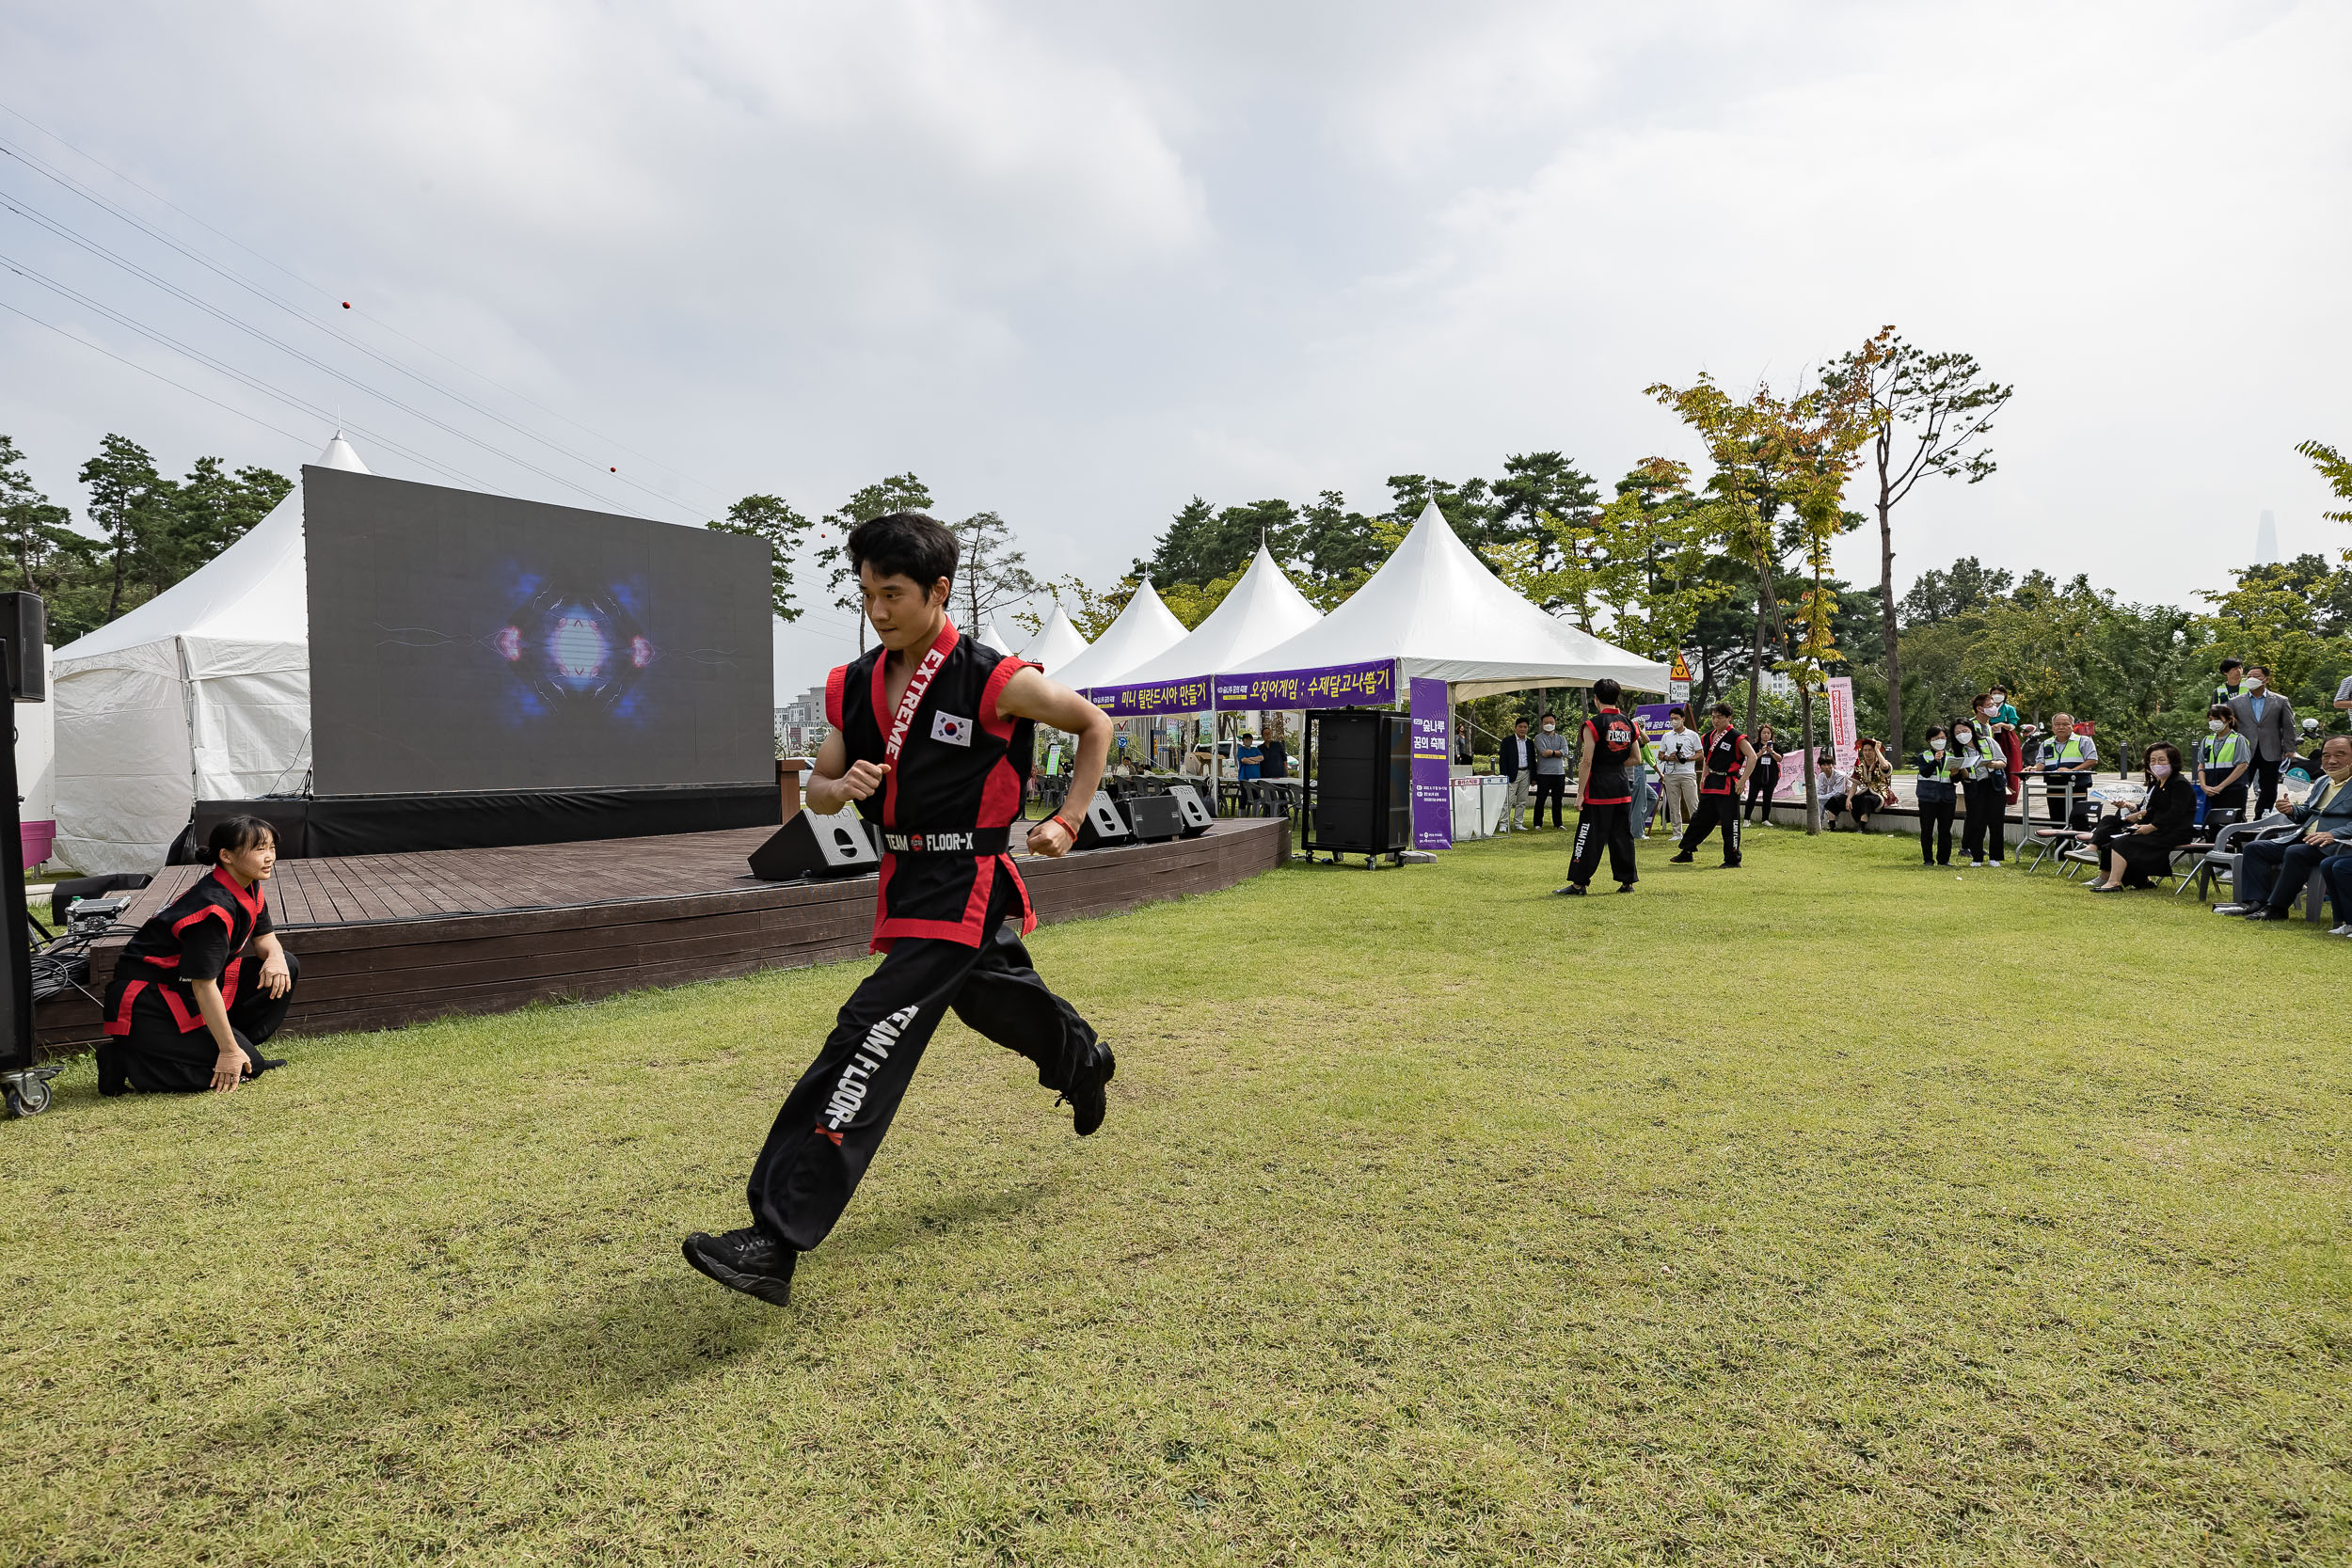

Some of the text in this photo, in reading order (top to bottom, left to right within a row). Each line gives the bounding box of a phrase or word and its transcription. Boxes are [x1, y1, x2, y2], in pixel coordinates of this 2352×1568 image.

[1121, 682, 1206, 709] 미니 틸란드시아 만들기
[1249, 678, 1298, 703] 오징어게임
[1308, 669, 1390, 698] 수제달고나뽑기
[886, 648, 946, 760] EXTREME
[1422, 720, 1445, 733] 숲나루
[1414, 736, 1446, 751] 꿈의 축제
[884, 832, 974, 851] TEAM FLOOR-X
[1579, 823, 1591, 839] TEAM
[862, 1005, 919, 1059] TEAM
